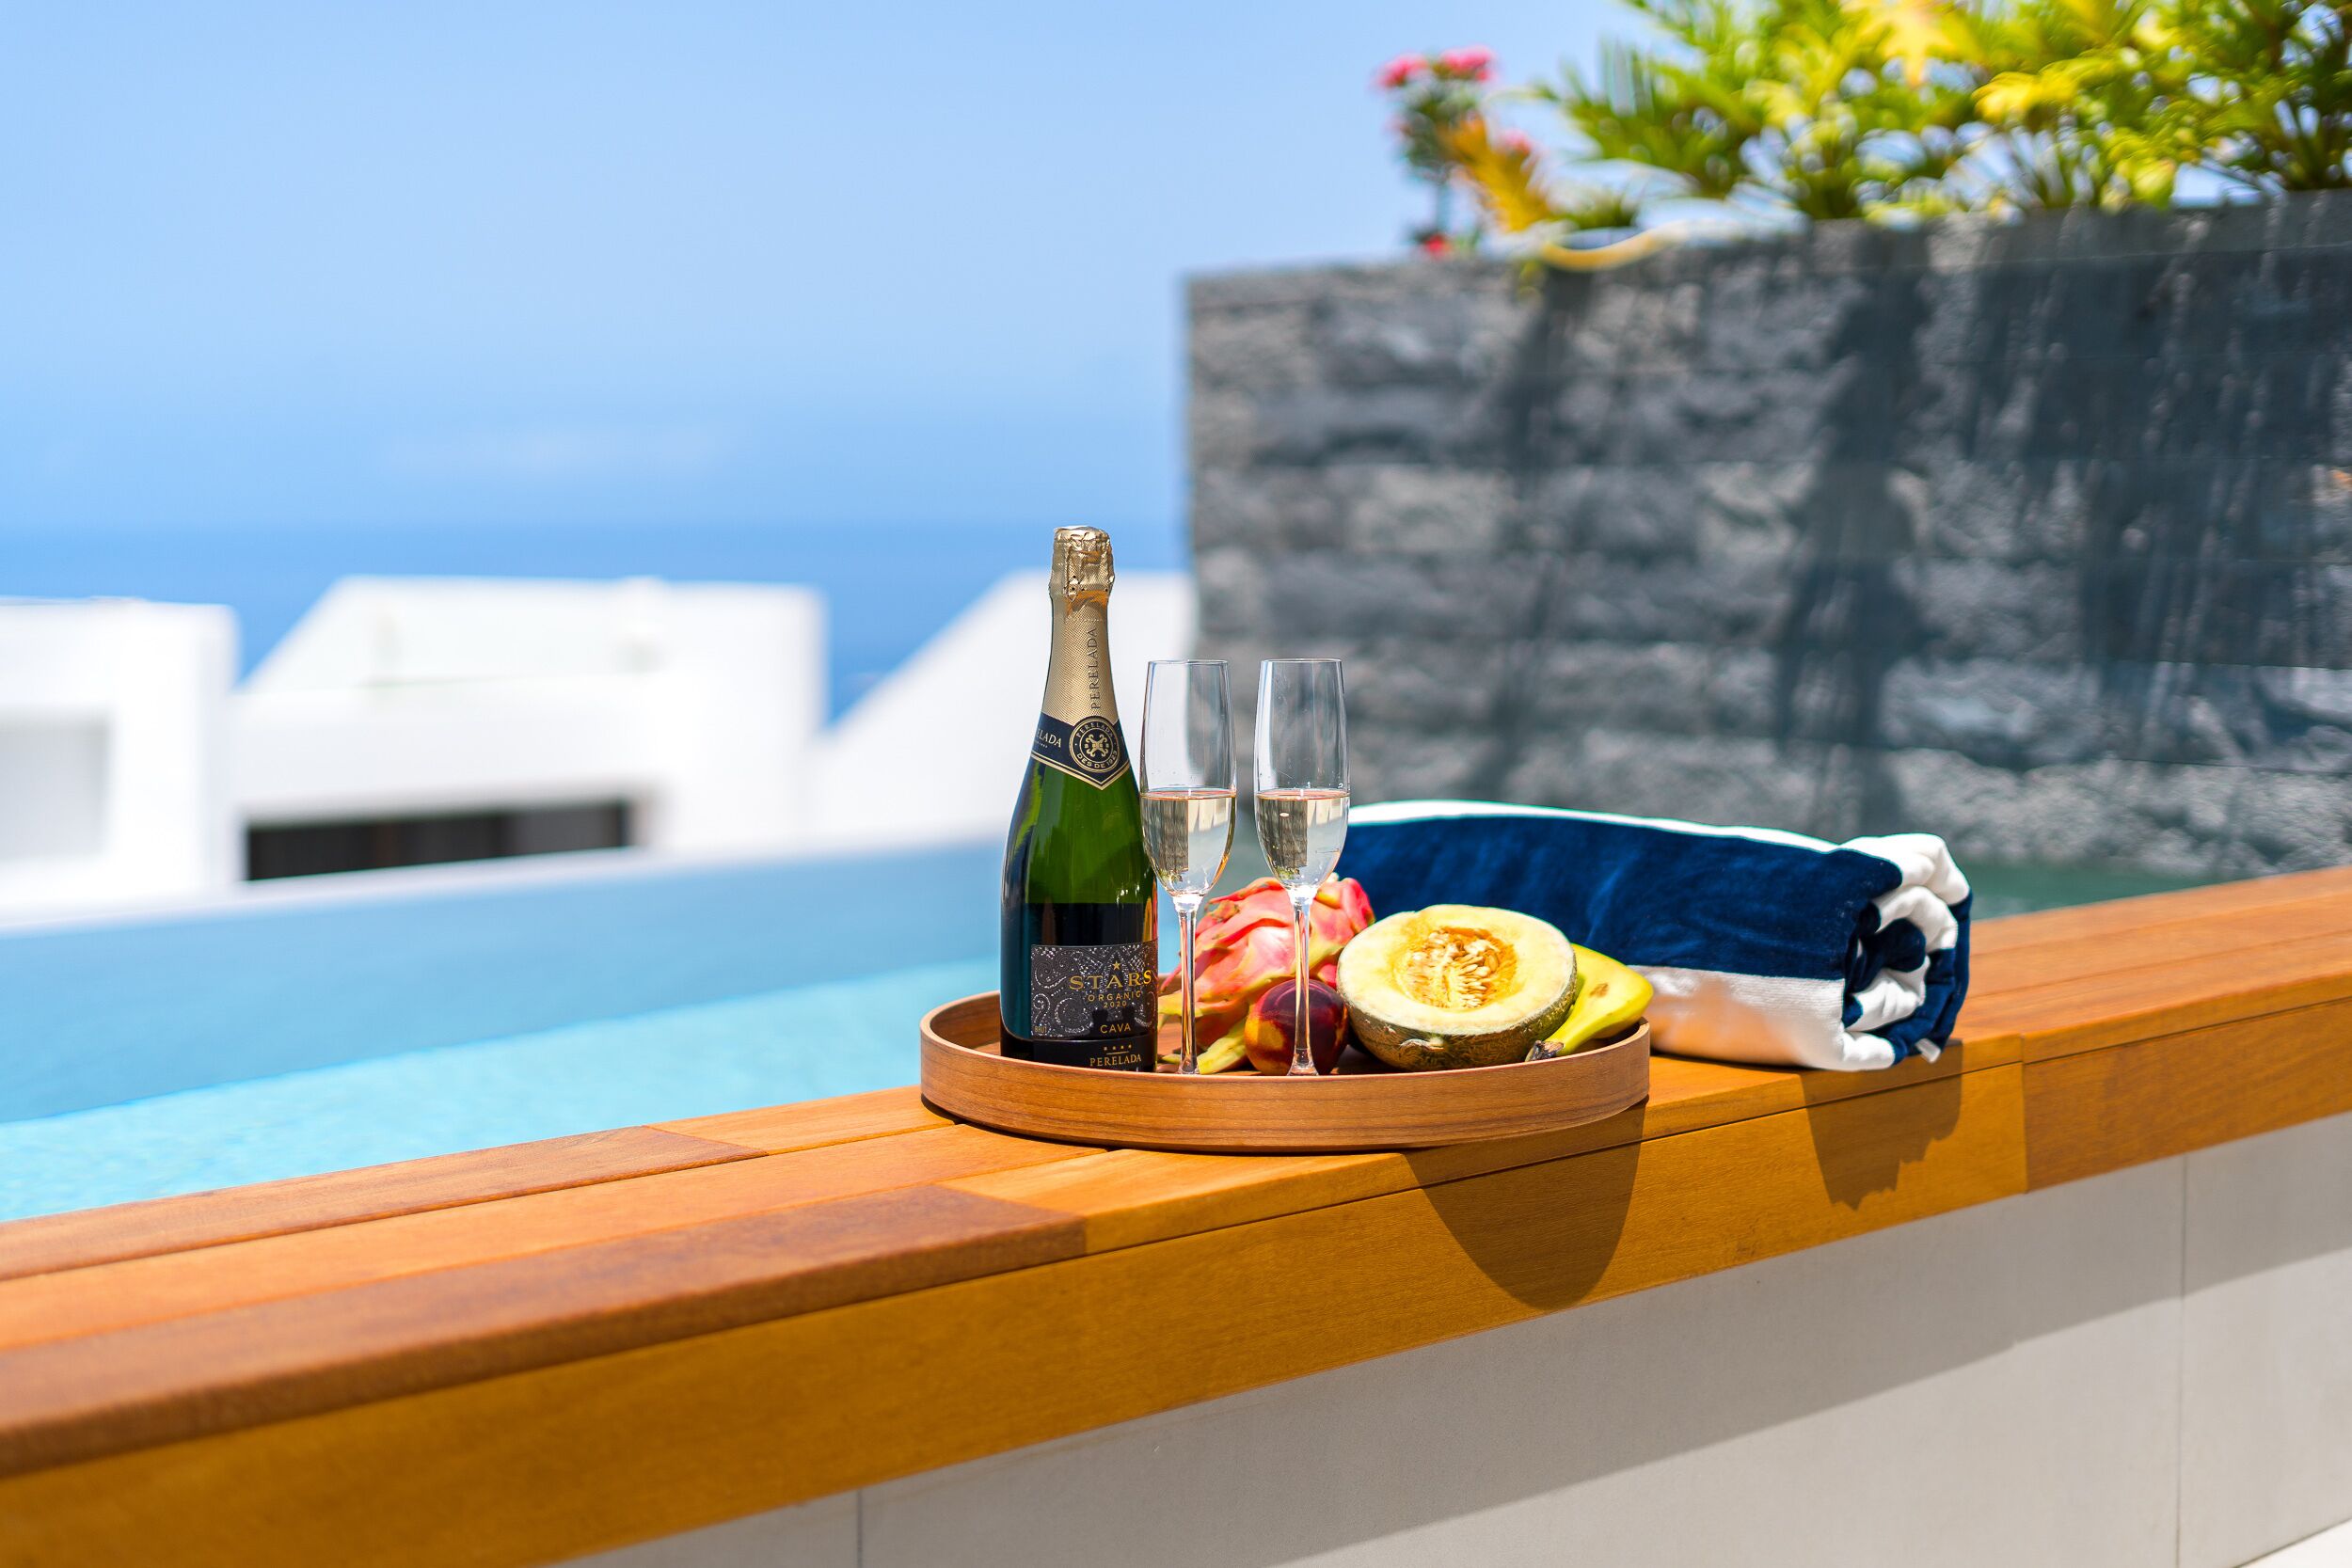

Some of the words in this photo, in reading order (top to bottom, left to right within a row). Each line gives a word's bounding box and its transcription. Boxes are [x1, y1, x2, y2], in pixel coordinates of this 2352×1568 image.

[1087, 627, 1101, 710] PERELADA
[1076, 722, 1113, 737] PERELADA
[1069, 970, 1152, 990] STARS
[1088, 990, 1141, 1002] ORGANIC
[1100, 1023, 1131, 1034] CAVA
[1089, 1053, 1142, 1067] PERELADA
